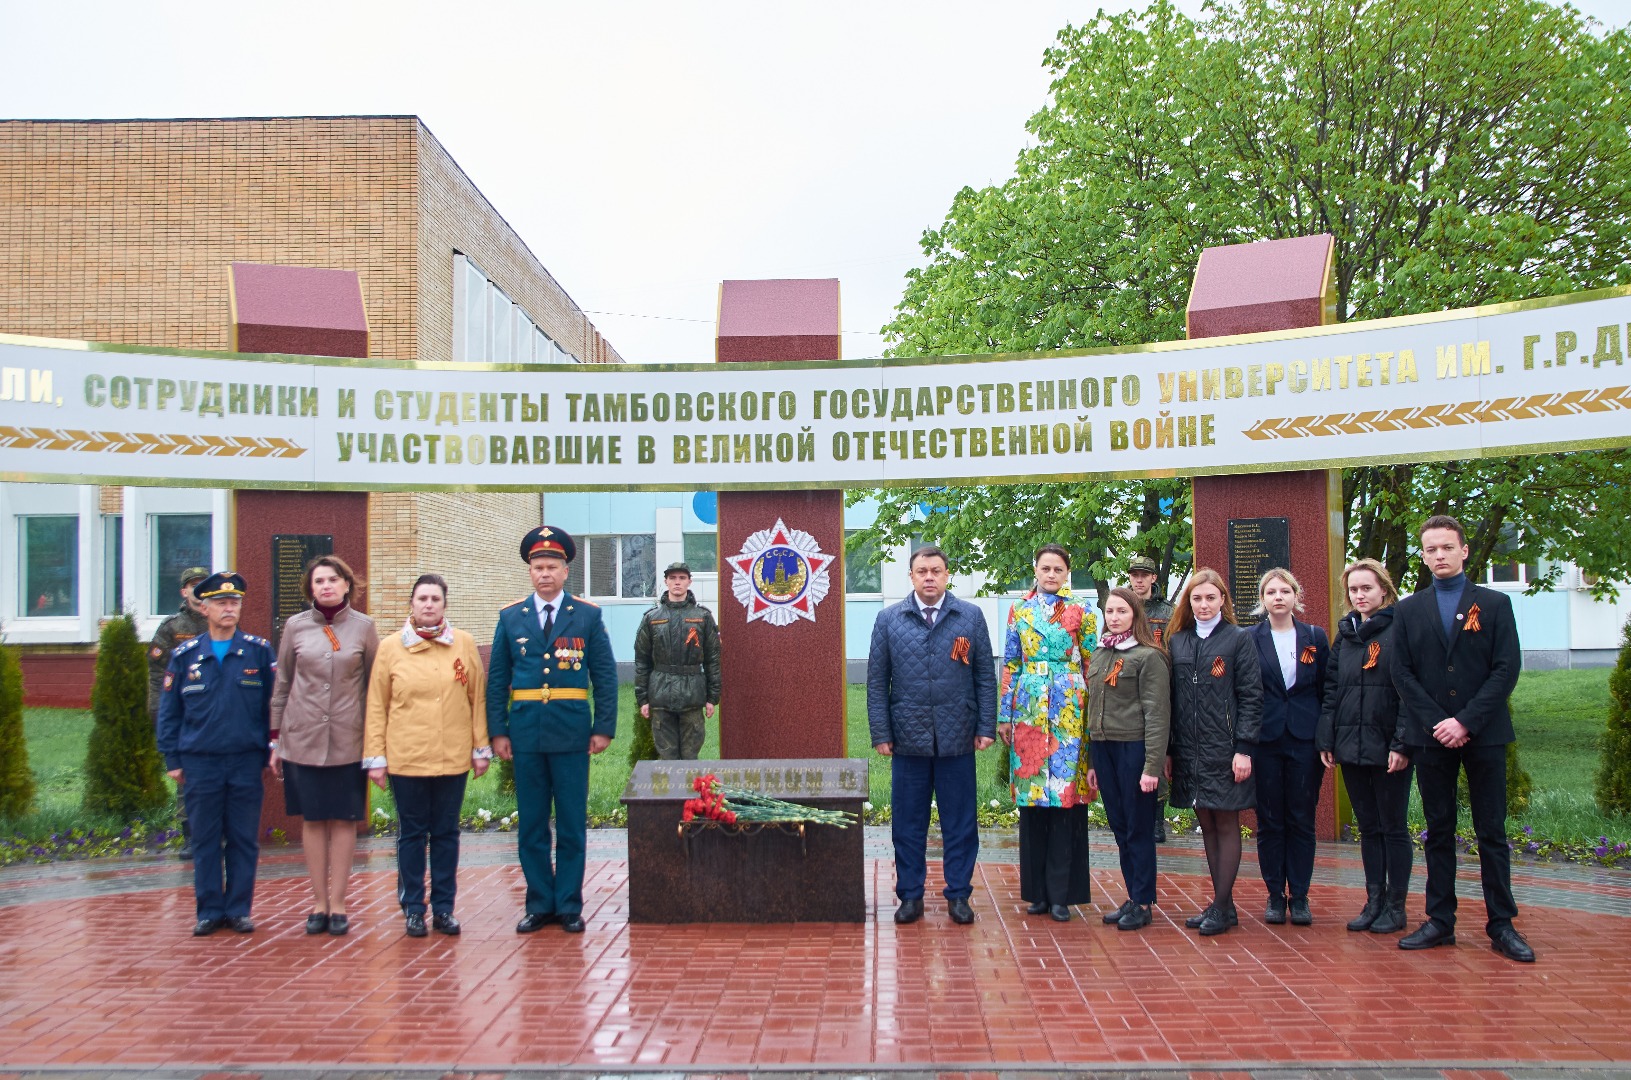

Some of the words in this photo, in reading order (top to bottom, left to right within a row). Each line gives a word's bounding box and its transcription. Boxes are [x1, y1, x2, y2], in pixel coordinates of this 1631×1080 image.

[0, 367, 64, 409] ЛИ,
[84, 373, 318, 419] СОТРУДНИКИ
[338, 388, 356, 419] И
[375, 391, 549, 425] СТУДЕНТЫ
[565, 391, 797, 423] ТАМБОВСКОГО
[813, 376, 1140, 421] ГОСУДАРСТВЕННОГО
[1157, 350, 1418, 404] УНИВЕРСИТЕТА
[1436, 340, 1505, 380] ИМ.
[337, 432, 622, 464] УЧАСТВОВАВШИЕ
[638, 435, 656, 464] В
[673, 426, 815, 464] ВЕЛИКОЙ
[832, 415, 1093, 461] ОТЕЧЕСТВЕННОЙ
[1110, 411, 1216, 453] ВОЙНЕ
[765, 549, 795, 558] СССР
